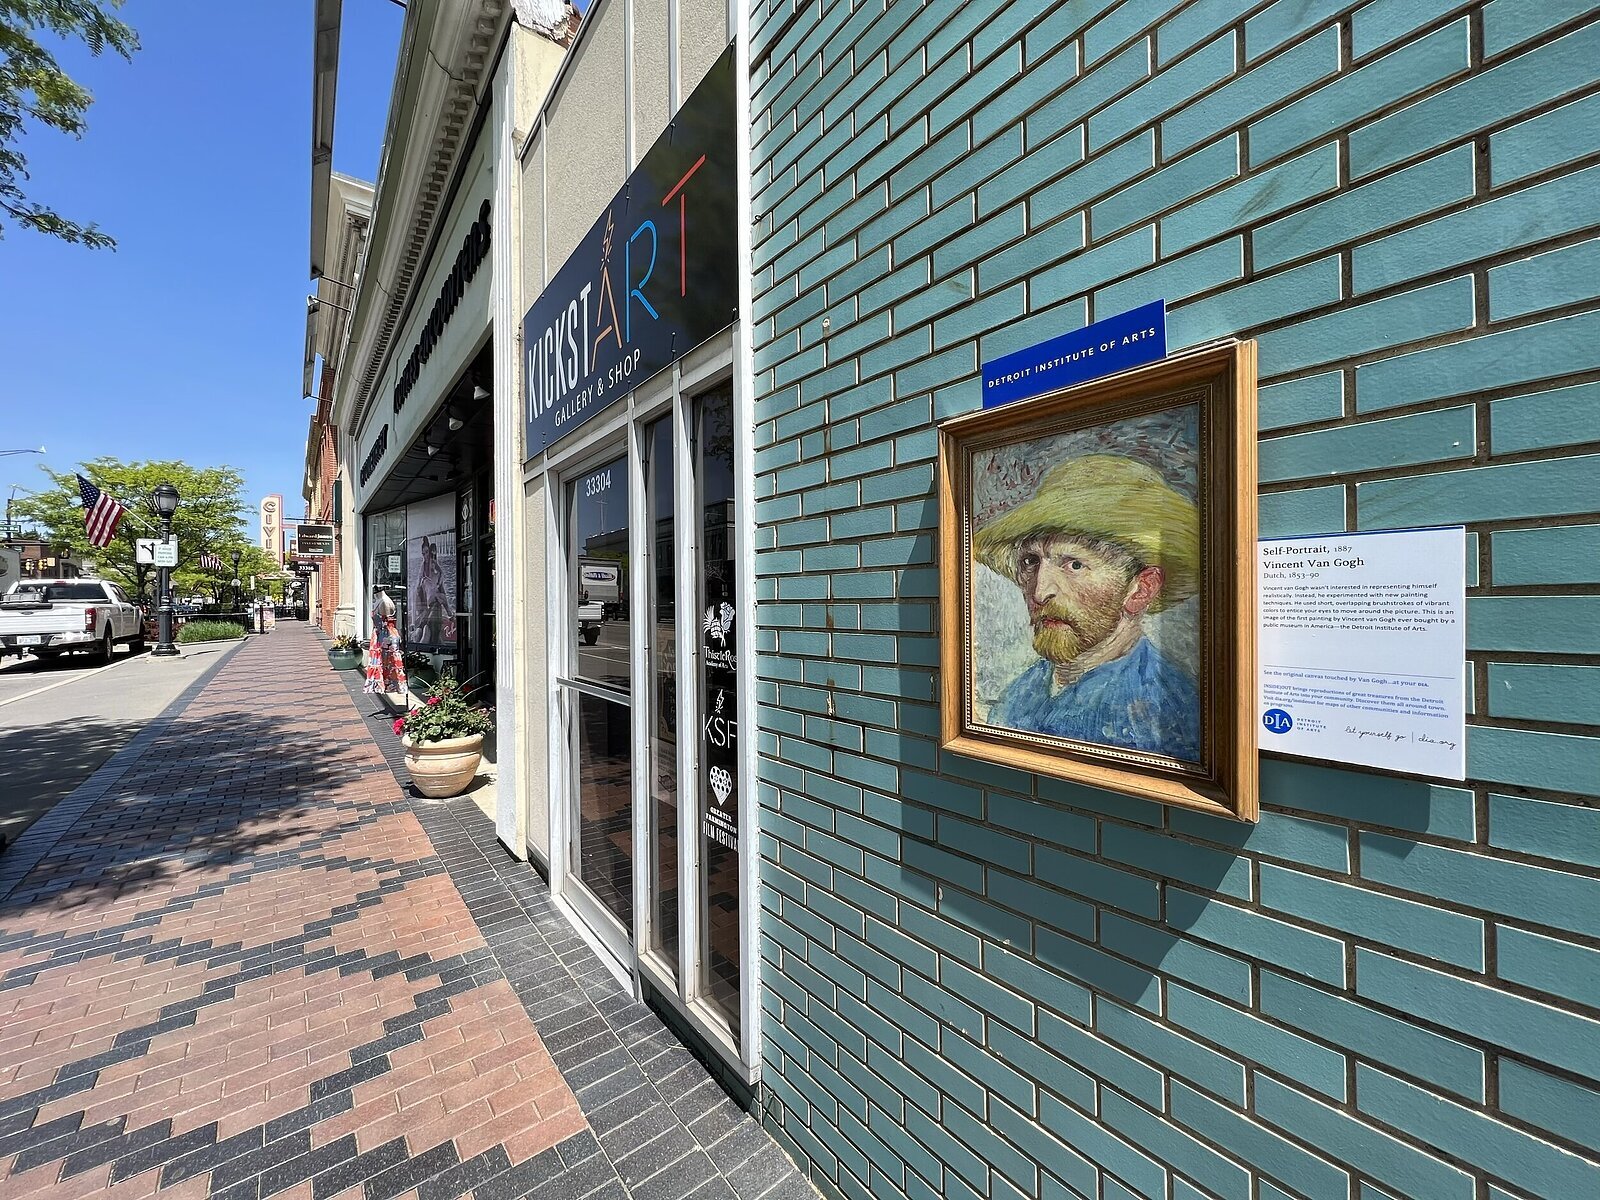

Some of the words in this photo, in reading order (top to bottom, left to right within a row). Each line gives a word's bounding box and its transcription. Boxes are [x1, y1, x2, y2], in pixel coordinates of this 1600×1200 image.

[528, 153, 707, 424] KICKSTART
[988, 368, 1031, 389] DETROIT
[1034, 346, 1094, 373] INSTITUTE
[1099, 340, 1116, 353] OF
[1121, 327, 1156, 346] ARTS
[554, 389, 594, 427] GALLERY
[596, 377, 604, 397] &
[608, 348, 642, 389] SHOP
[585, 469, 612, 497] 33304
[1263, 545, 1330, 556] Self-Portrait,
[1334, 545, 1352, 553] 1887
[1263, 561, 1304, 569] Vincent
[1307, 559, 1330, 567] Van
[1333, 557, 1365, 569] Gogh
[702, 713, 737, 749] KSF
[1264, 713, 1291, 729] DIA
[703, 820, 715, 839] FILM
